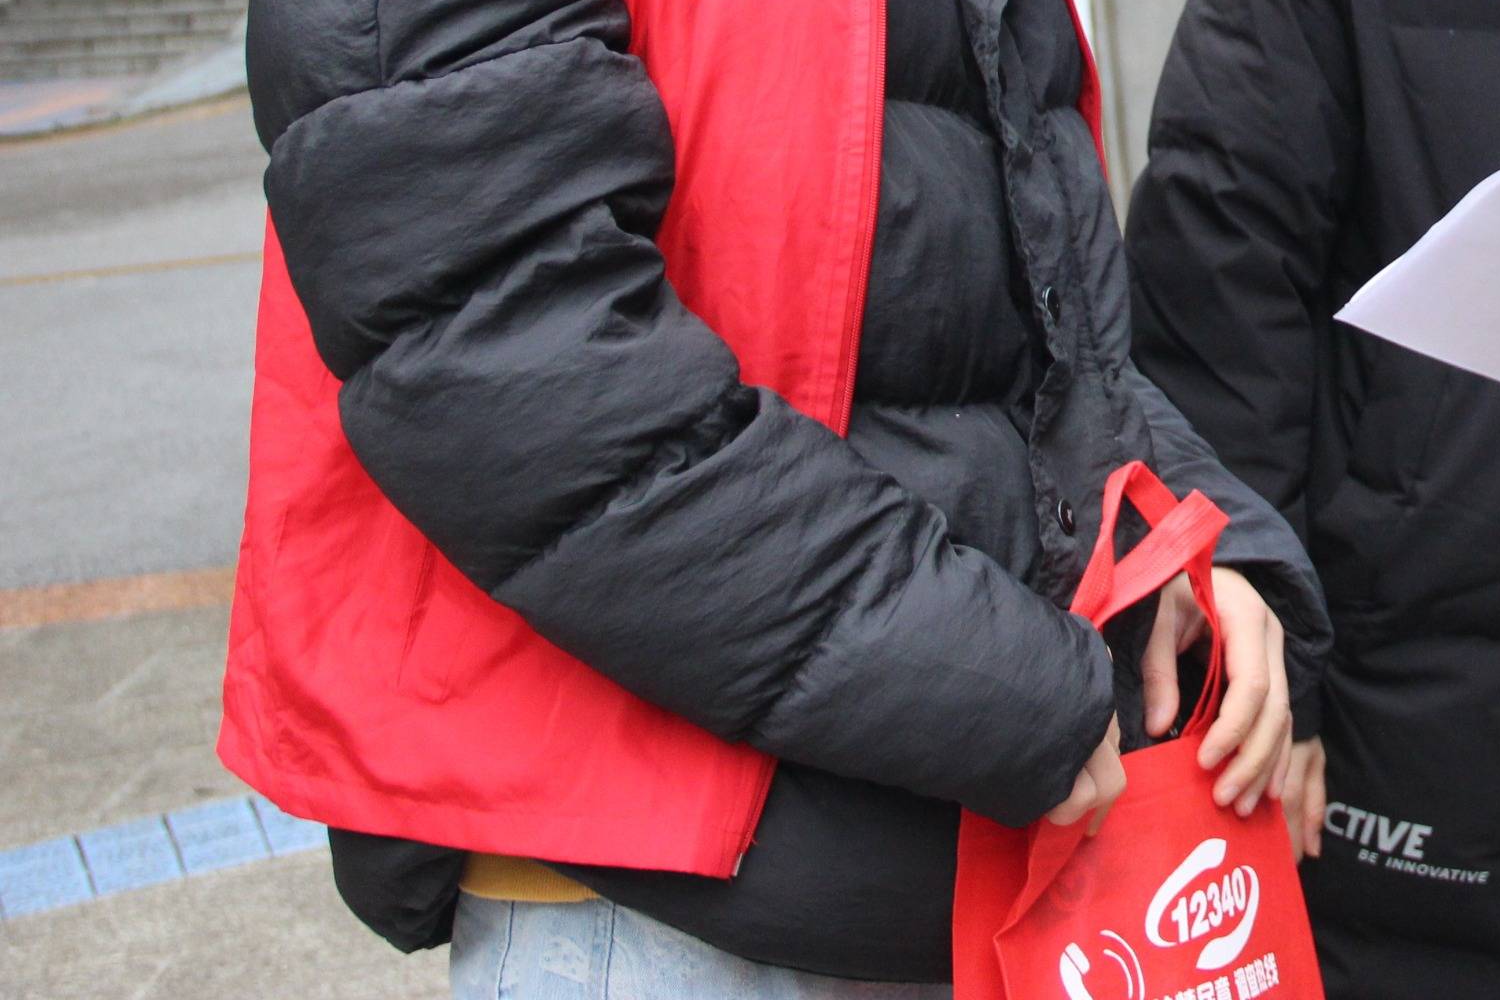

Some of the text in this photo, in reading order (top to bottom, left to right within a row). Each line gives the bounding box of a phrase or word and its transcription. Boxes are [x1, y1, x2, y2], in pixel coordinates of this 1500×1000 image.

[1358, 849, 1490, 884] BE INNOVATIVE
[1171, 867, 1246, 943] 12340
